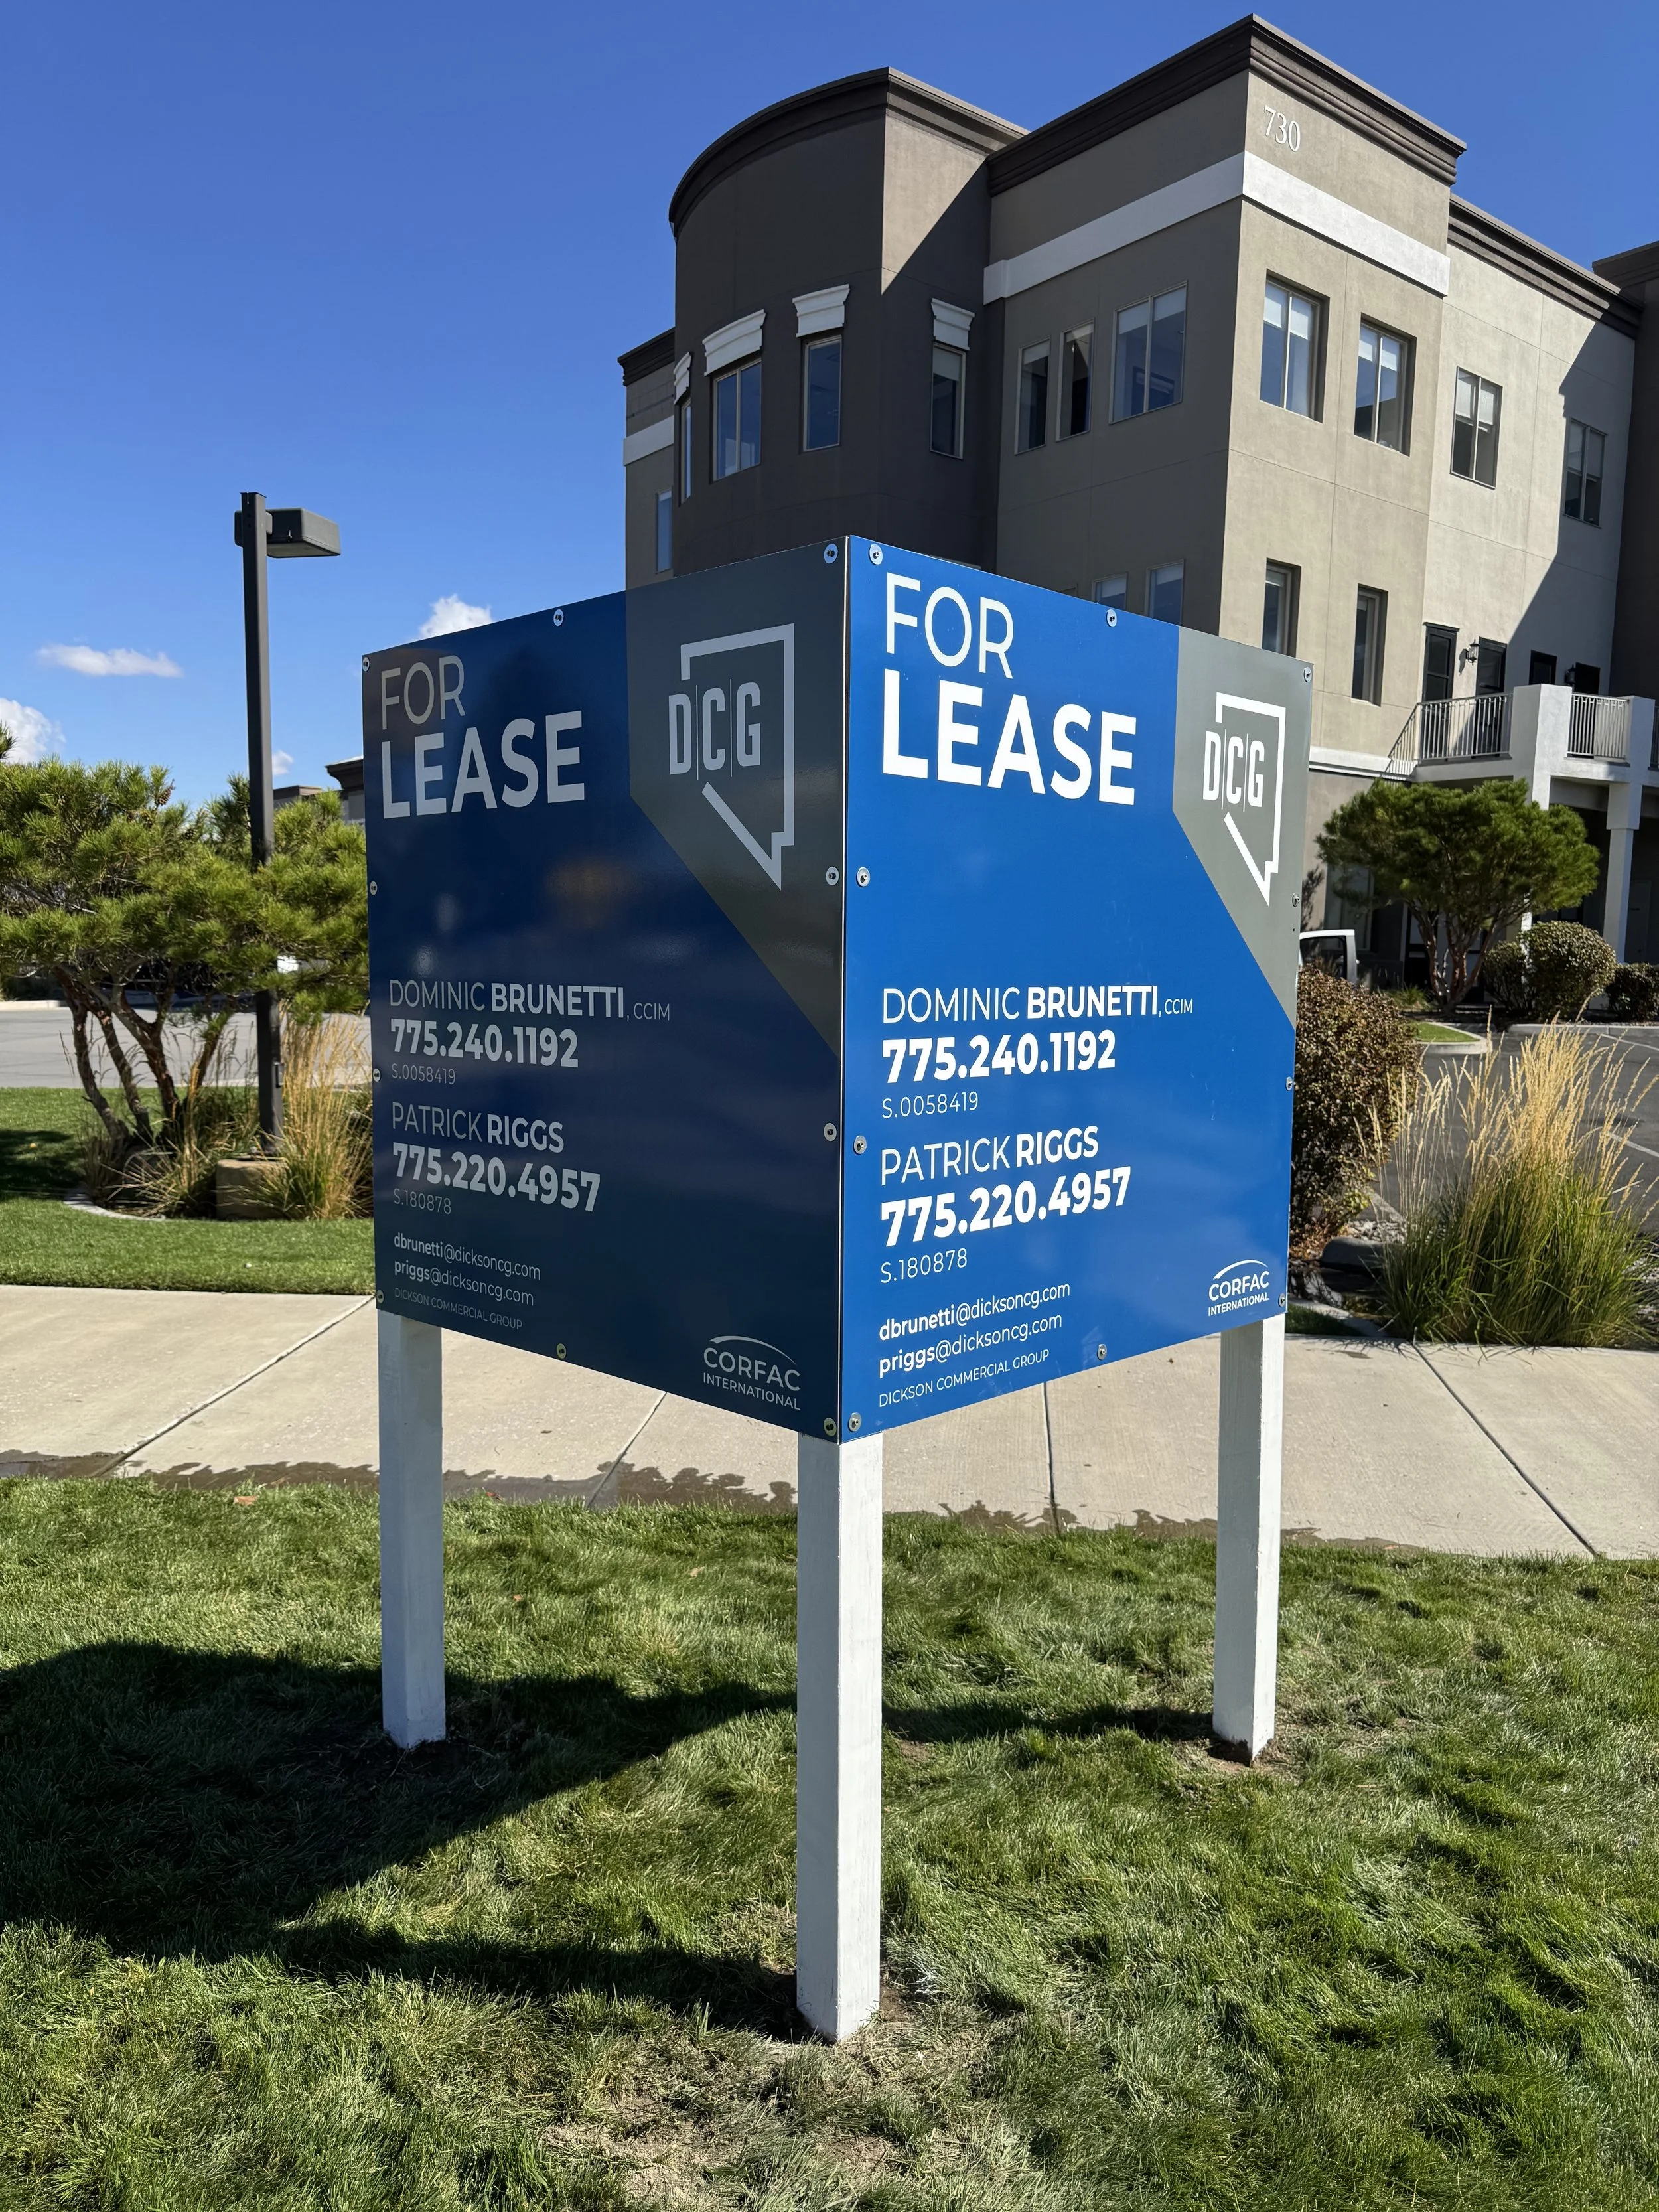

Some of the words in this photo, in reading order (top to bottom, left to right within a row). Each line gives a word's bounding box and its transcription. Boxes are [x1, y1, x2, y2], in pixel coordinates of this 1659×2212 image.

[1264, 105, 1301, 152] 730
[886, 572, 1014, 679] FOR
[381, 655, 466, 730] FOR
[883, 668, 1136, 806] LEASE
[382, 710, 585, 819] LEASE
[389, 980, 485, 1011] DOMINIC
[491, 983, 630, 1022] BRUNETTI,
[633, 1002, 670, 1021] CCIM
[883, 986, 1021, 1023] DOMINIC
[1027, 985, 1162, 1019] BRUNETTI,
[1164, 997, 1193, 1015] CCIM
[390, 1018, 579, 1068] 775.240.1192
[882, 1029, 1116, 1084] 775.240.1192
[391, 1063, 456, 1085] S.0058419
[392, 1102, 483, 1142] PATRICK
[487, 1114, 565, 1153] RIGGS
[882, 1091, 979, 1118] S.0058419
[393, 1142, 601, 1212] 775.220.4957
[881, 1135, 1011, 1186] PATRICK
[1016, 1126, 1099, 1167] RIGGS
[393, 1188, 451, 1215] S.180878
[881, 1166, 1131, 1247] 775.220.4957
[394, 1232, 541, 1280] dbrunetti@dicksoncg.com
[881, 1248, 968, 1284] S.180878
[394, 1260, 534, 1306] priggs@dicksoncg.com
[1208, 1270, 1270, 1301] CORFAC
[1208, 1292, 1270, 1317] INTERNATIONAL
[394, 1288, 429, 1306] DICKSON
[431, 1297, 488, 1322] COMMERCIAL
[490, 1312, 522, 1329] GROUP
[879, 1283, 1070, 1341] dbrunetti@dicksoncg.com
[703, 1347, 800, 1391] CORFAC
[879, 1314, 1062, 1378] priggs@dicksoncg.com
[703, 1372, 801, 1411] INTERNATIONAL
[879, 1380, 933, 1407] DICKSON
[936, 1360, 1011, 1392] COMMERCIAL
[1013, 1349, 1050, 1370] GROUP
